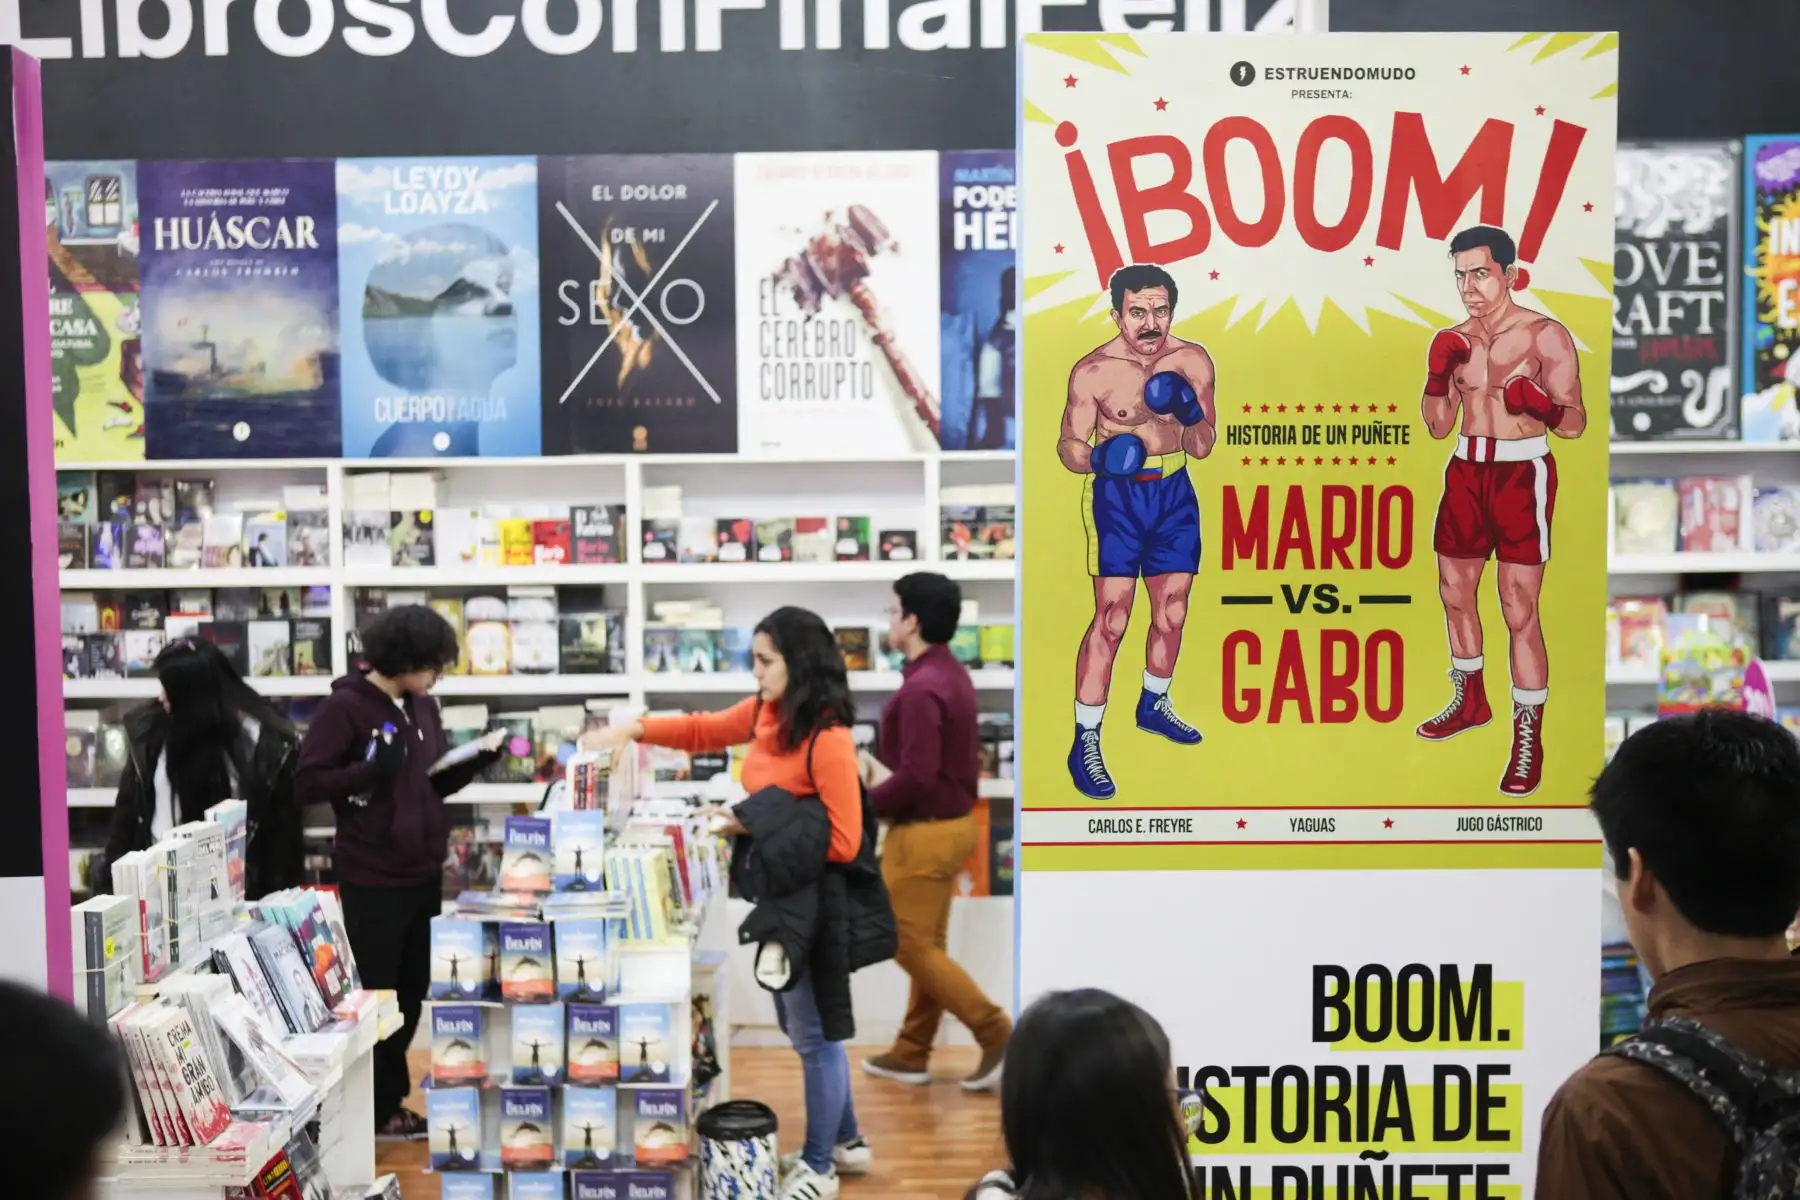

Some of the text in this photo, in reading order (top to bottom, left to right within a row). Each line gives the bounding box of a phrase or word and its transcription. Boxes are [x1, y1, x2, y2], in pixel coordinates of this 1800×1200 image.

[1264, 67, 1416, 80] ESTRUENDOMUDO
[1291, 89, 1353, 99] PRESENTA:
[392, 165, 479, 191] LEYDY
[384, 190, 489, 215] LOAYZA
[592, 184, 687, 201] EL DOLOR
[153, 210, 319, 251] HUÁSCAR
[611, 227, 666, 244] DE MI
[760, 278, 781, 317] EL
[760, 319, 856, 359] CEREBRO
[760, 361, 873, 400] CORRUPTO
[374, 395, 445, 423] CUERPO
[1226, 420, 1410, 445] HISTORIA DE UN PUÑETE
[1221, 484, 1415, 571] MARIO
[1280, 583, 1353, 615] VS.
[1221, 628, 1405, 725] GABO
[1088, 818, 1193, 834] CARLOS E. FREYRE
[1289, 817, 1336, 833] YAGUAS
[1456, 813, 1543, 832] JUGO GÁSTRICO
[1311, 963, 1511, 1043] BOOM.
[1177, 1063, 1511, 1144] STORIA DE
